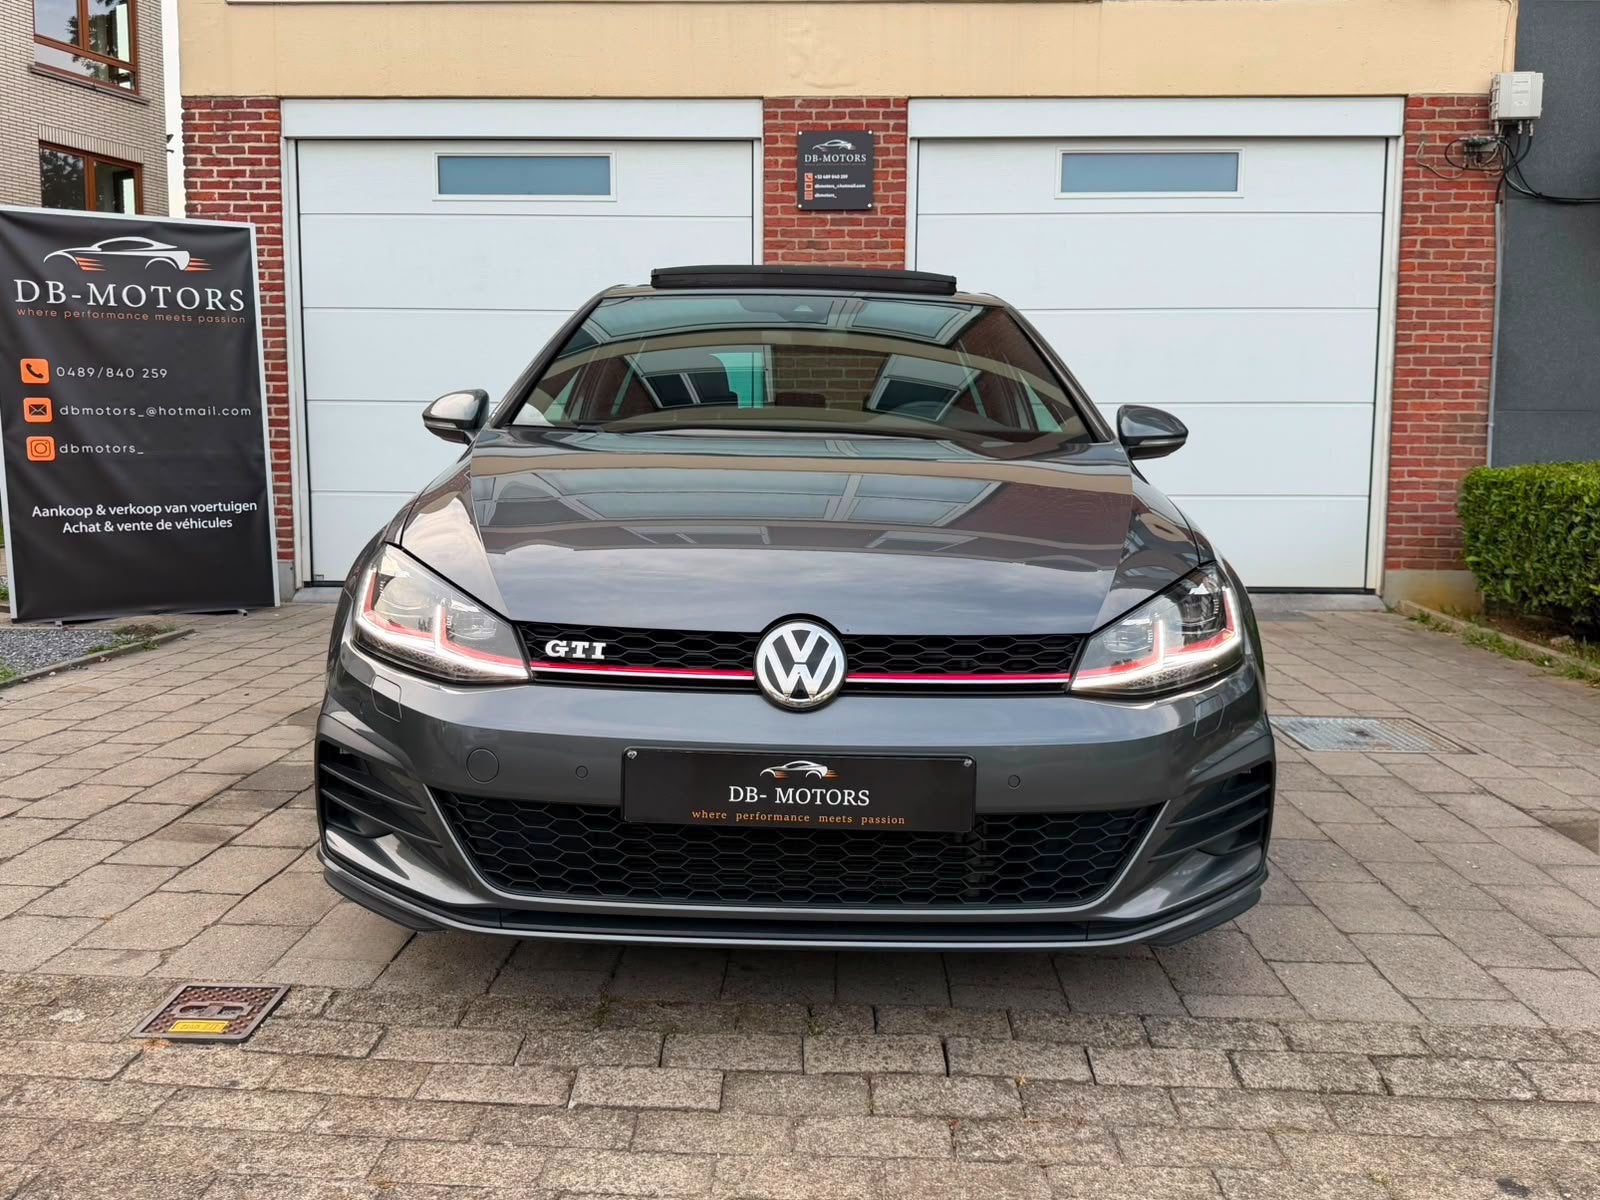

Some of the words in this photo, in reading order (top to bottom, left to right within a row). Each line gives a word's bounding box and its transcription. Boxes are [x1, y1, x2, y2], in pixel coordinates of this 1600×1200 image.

[804, 154, 867, 163] DB-MOTORS
[14, 279, 245, 311] DB-MOTORS
[17, 308, 57, 318] where
[64, 309, 149, 321] performance
[155, 313, 193, 322] meets
[198, 314, 246, 324] passion
[56, 366, 135, 378] 0489/840
[142, 367, 168, 379] 259
[59, 405, 252, 418] dbmotors_@hotmail.com
[59, 442, 144, 454] dbmotors_
[32, 505, 93, 519] Aankoop
[96, 504, 106, 516] &
[109, 503, 161, 517] verkoop
[165, 504, 187, 514] van
[190, 500, 257, 515] voertuigen
[62, 520, 102, 534] Achat
[105, 520, 114, 532] &
[117, 520, 153, 532] vente
[156, 518, 173, 530] de
[175, 516, 233, 530] véhicules
[544, 639, 607, 660] GTI
[761, 624, 841, 701] VW
[728, 786, 767, 803] DB-
[774, 787, 871, 807] MOTORS
[691, 809, 728, 820] where
[736, 811, 810, 824] performance
[819, 815, 853, 824] meets
[861, 815, 905, 827] passion
